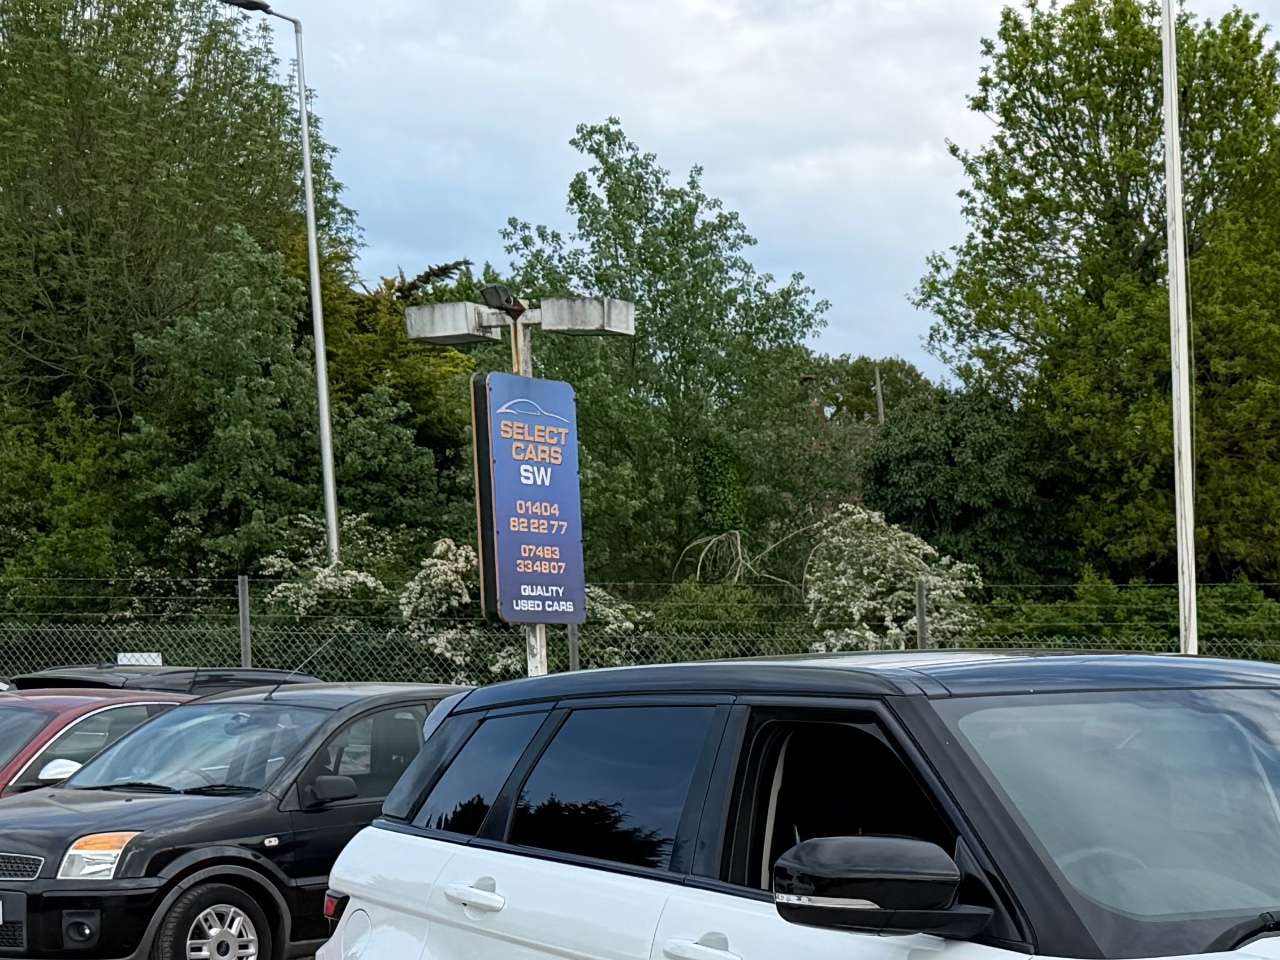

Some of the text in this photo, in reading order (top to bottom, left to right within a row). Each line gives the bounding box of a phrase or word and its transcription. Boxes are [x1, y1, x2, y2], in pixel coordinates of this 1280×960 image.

[501, 420, 568, 446] SELECT
[512, 441, 563, 466] CARS
[520, 464, 551, 487] SW
[516, 500, 560, 517] 01404
[521, 585, 564, 597] QUALITY
[513, 600, 574, 613] USED CARS
